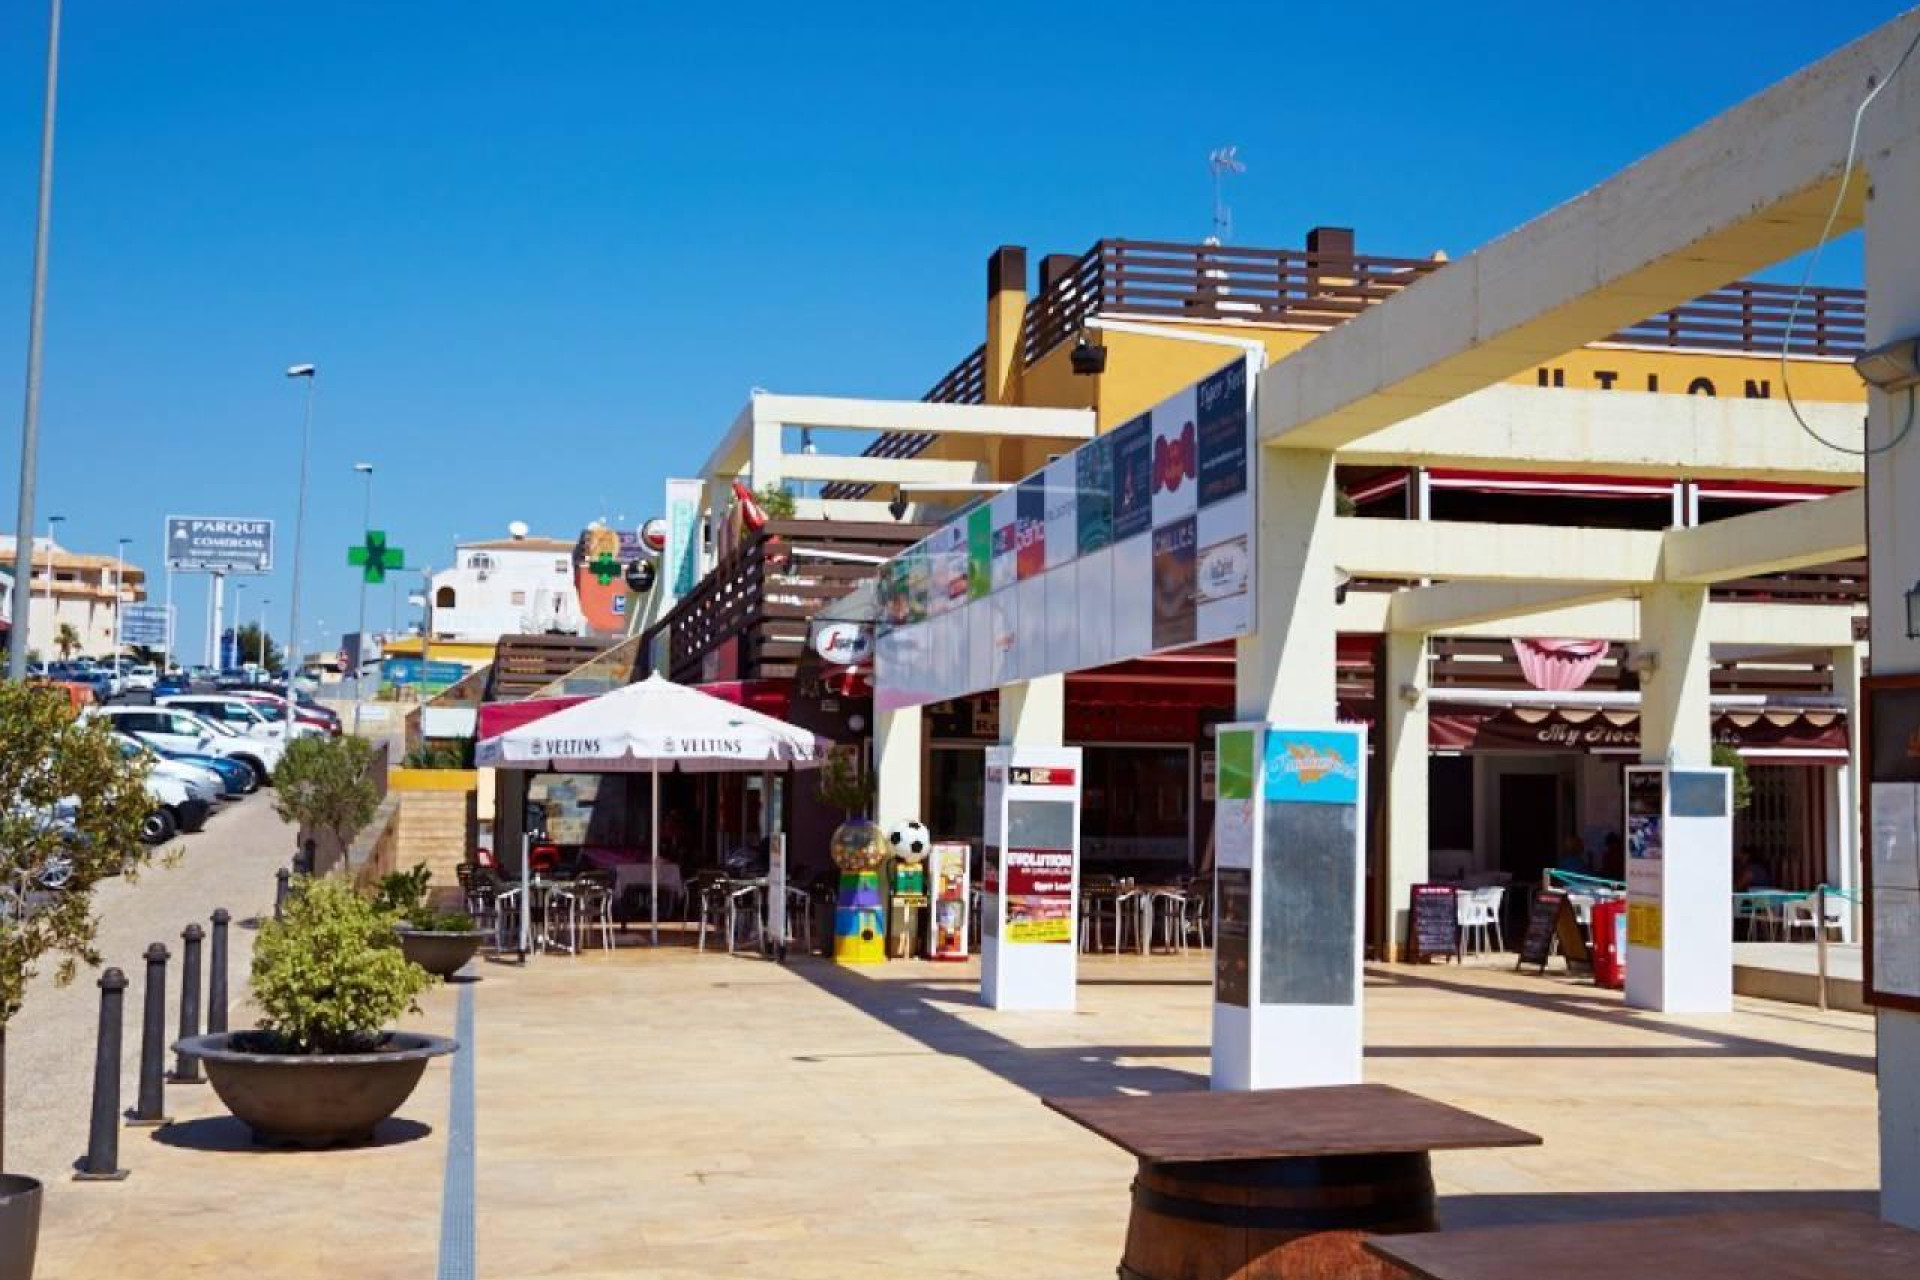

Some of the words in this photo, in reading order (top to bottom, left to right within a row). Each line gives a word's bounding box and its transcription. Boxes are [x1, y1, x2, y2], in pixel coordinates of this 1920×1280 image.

[192, 520, 265, 535] PARQUE
[1537, 724, 1579, 746] My
[546, 738, 600, 755] VELTINS
[681, 738, 742, 753] VELTINS
